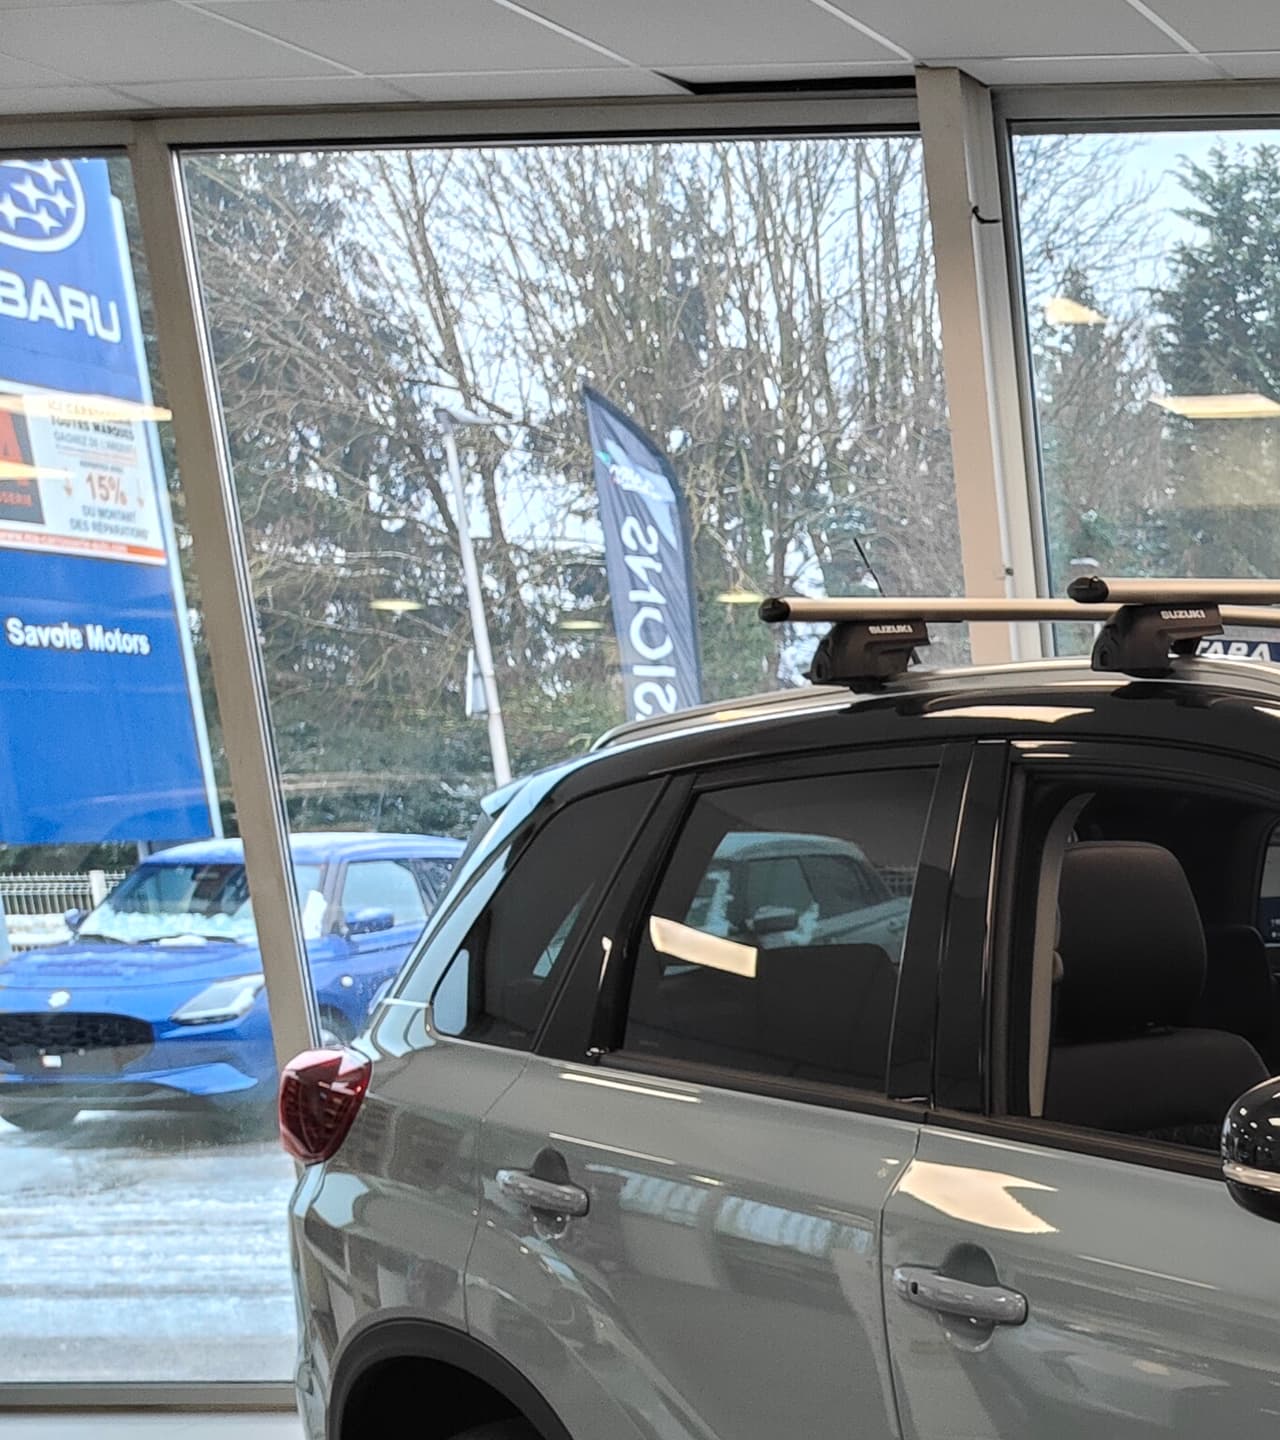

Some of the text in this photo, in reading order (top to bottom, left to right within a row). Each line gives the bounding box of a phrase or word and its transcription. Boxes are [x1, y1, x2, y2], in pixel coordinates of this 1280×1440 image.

[86, 472, 128, 506] 15%
[1160, 608, 1206, 620] SUZUKI
[6, 617, 151, 656] Savoie Motors
[868, 624, 913, 635] SUZUKI
